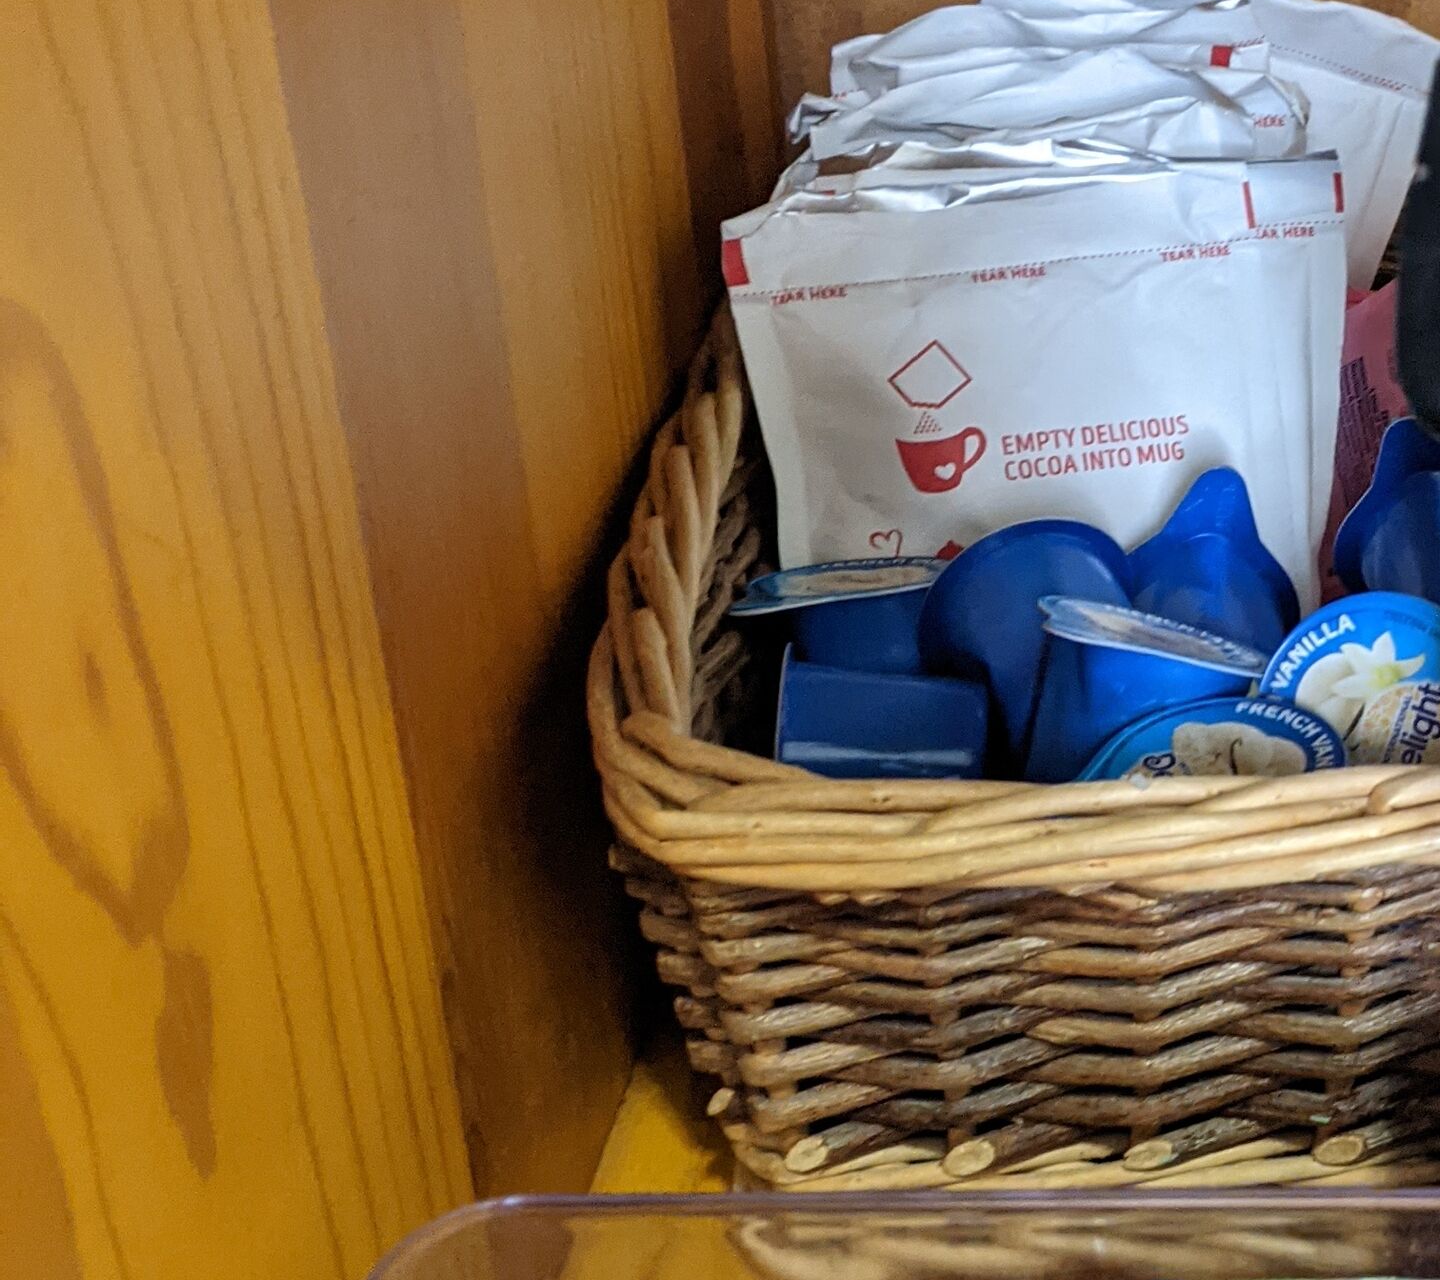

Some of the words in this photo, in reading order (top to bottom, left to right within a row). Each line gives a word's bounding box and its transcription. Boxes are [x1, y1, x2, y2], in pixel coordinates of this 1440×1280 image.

[1283, 225, 1316, 239] HERE
[1160, 250, 1196, 262] TEAR
[1199, 244, 1232, 259] HERE
[971, 269, 1006, 284] TEAR
[1011, 266, 1047, 280] HERE
[771, 289, 805, 306] TEAR
[809, 285, 849, 302] HERE
[1001, 427, 1076, 456] EMPTY
[1081, 415, 1190, 447] DELICIOUS
[1004, 454, 1078, 481] COCOA
[1083, 447, 1132, 472] INTO
[1137, 441, 1185, 466] MUG
[1270, 613, 1357, 690] VANILLA
[1234, 701, 1322, 739] FRENCH
[1311, 733, 1337, 769] VAN
